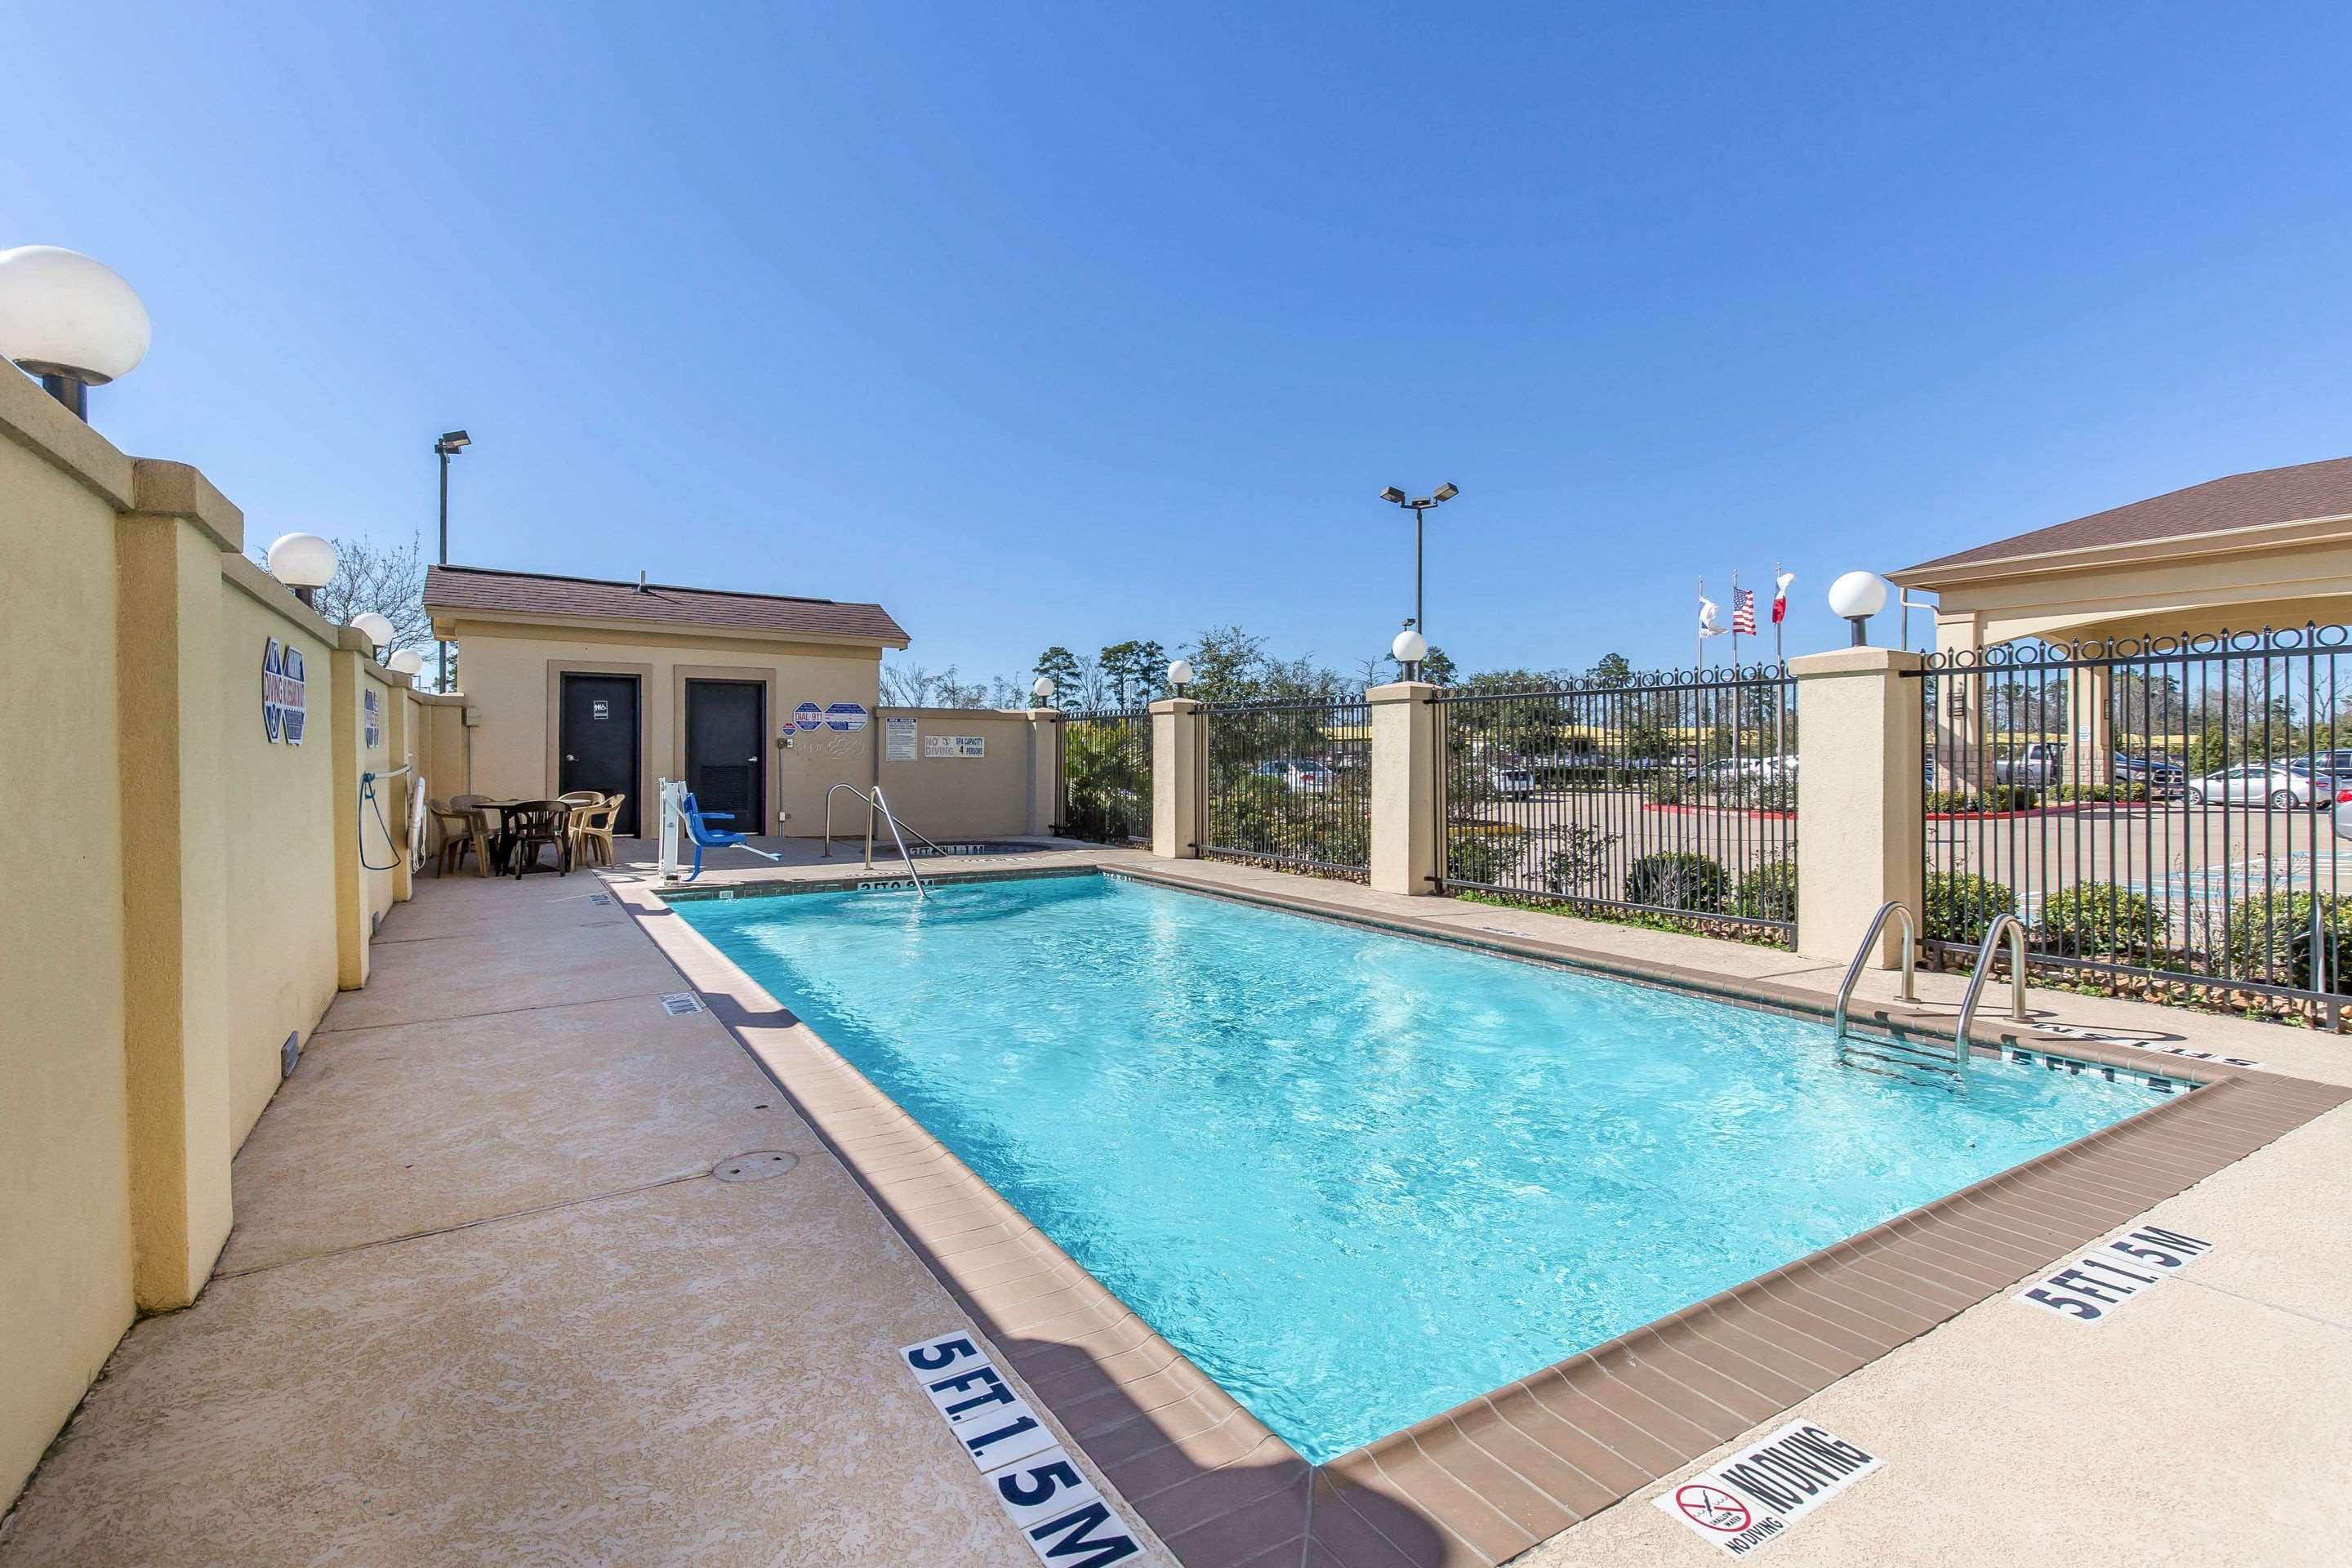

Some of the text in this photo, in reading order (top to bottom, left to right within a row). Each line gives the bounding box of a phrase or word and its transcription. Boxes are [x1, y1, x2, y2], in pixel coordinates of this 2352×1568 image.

[270, 644, 278, 673] NO
[795, 712, 810, 721] DIAL
[812, 712, 822, 721] 911
[925, 737, 938, 746] NO
[956, 737, 983, 746] SPA CAPACITY
[925, 746, 955, 756] DIVING
[959, 745, 982, 755] 4 PERSONS
[1719, 1426, 1873, 1514] NO DIVING
[1709, 1512, 1733, 1526] SHALLOW
[1724, 1515, 1742, 1526] WATER
[1724, 1517, 1784, 1555] NO DIVING
